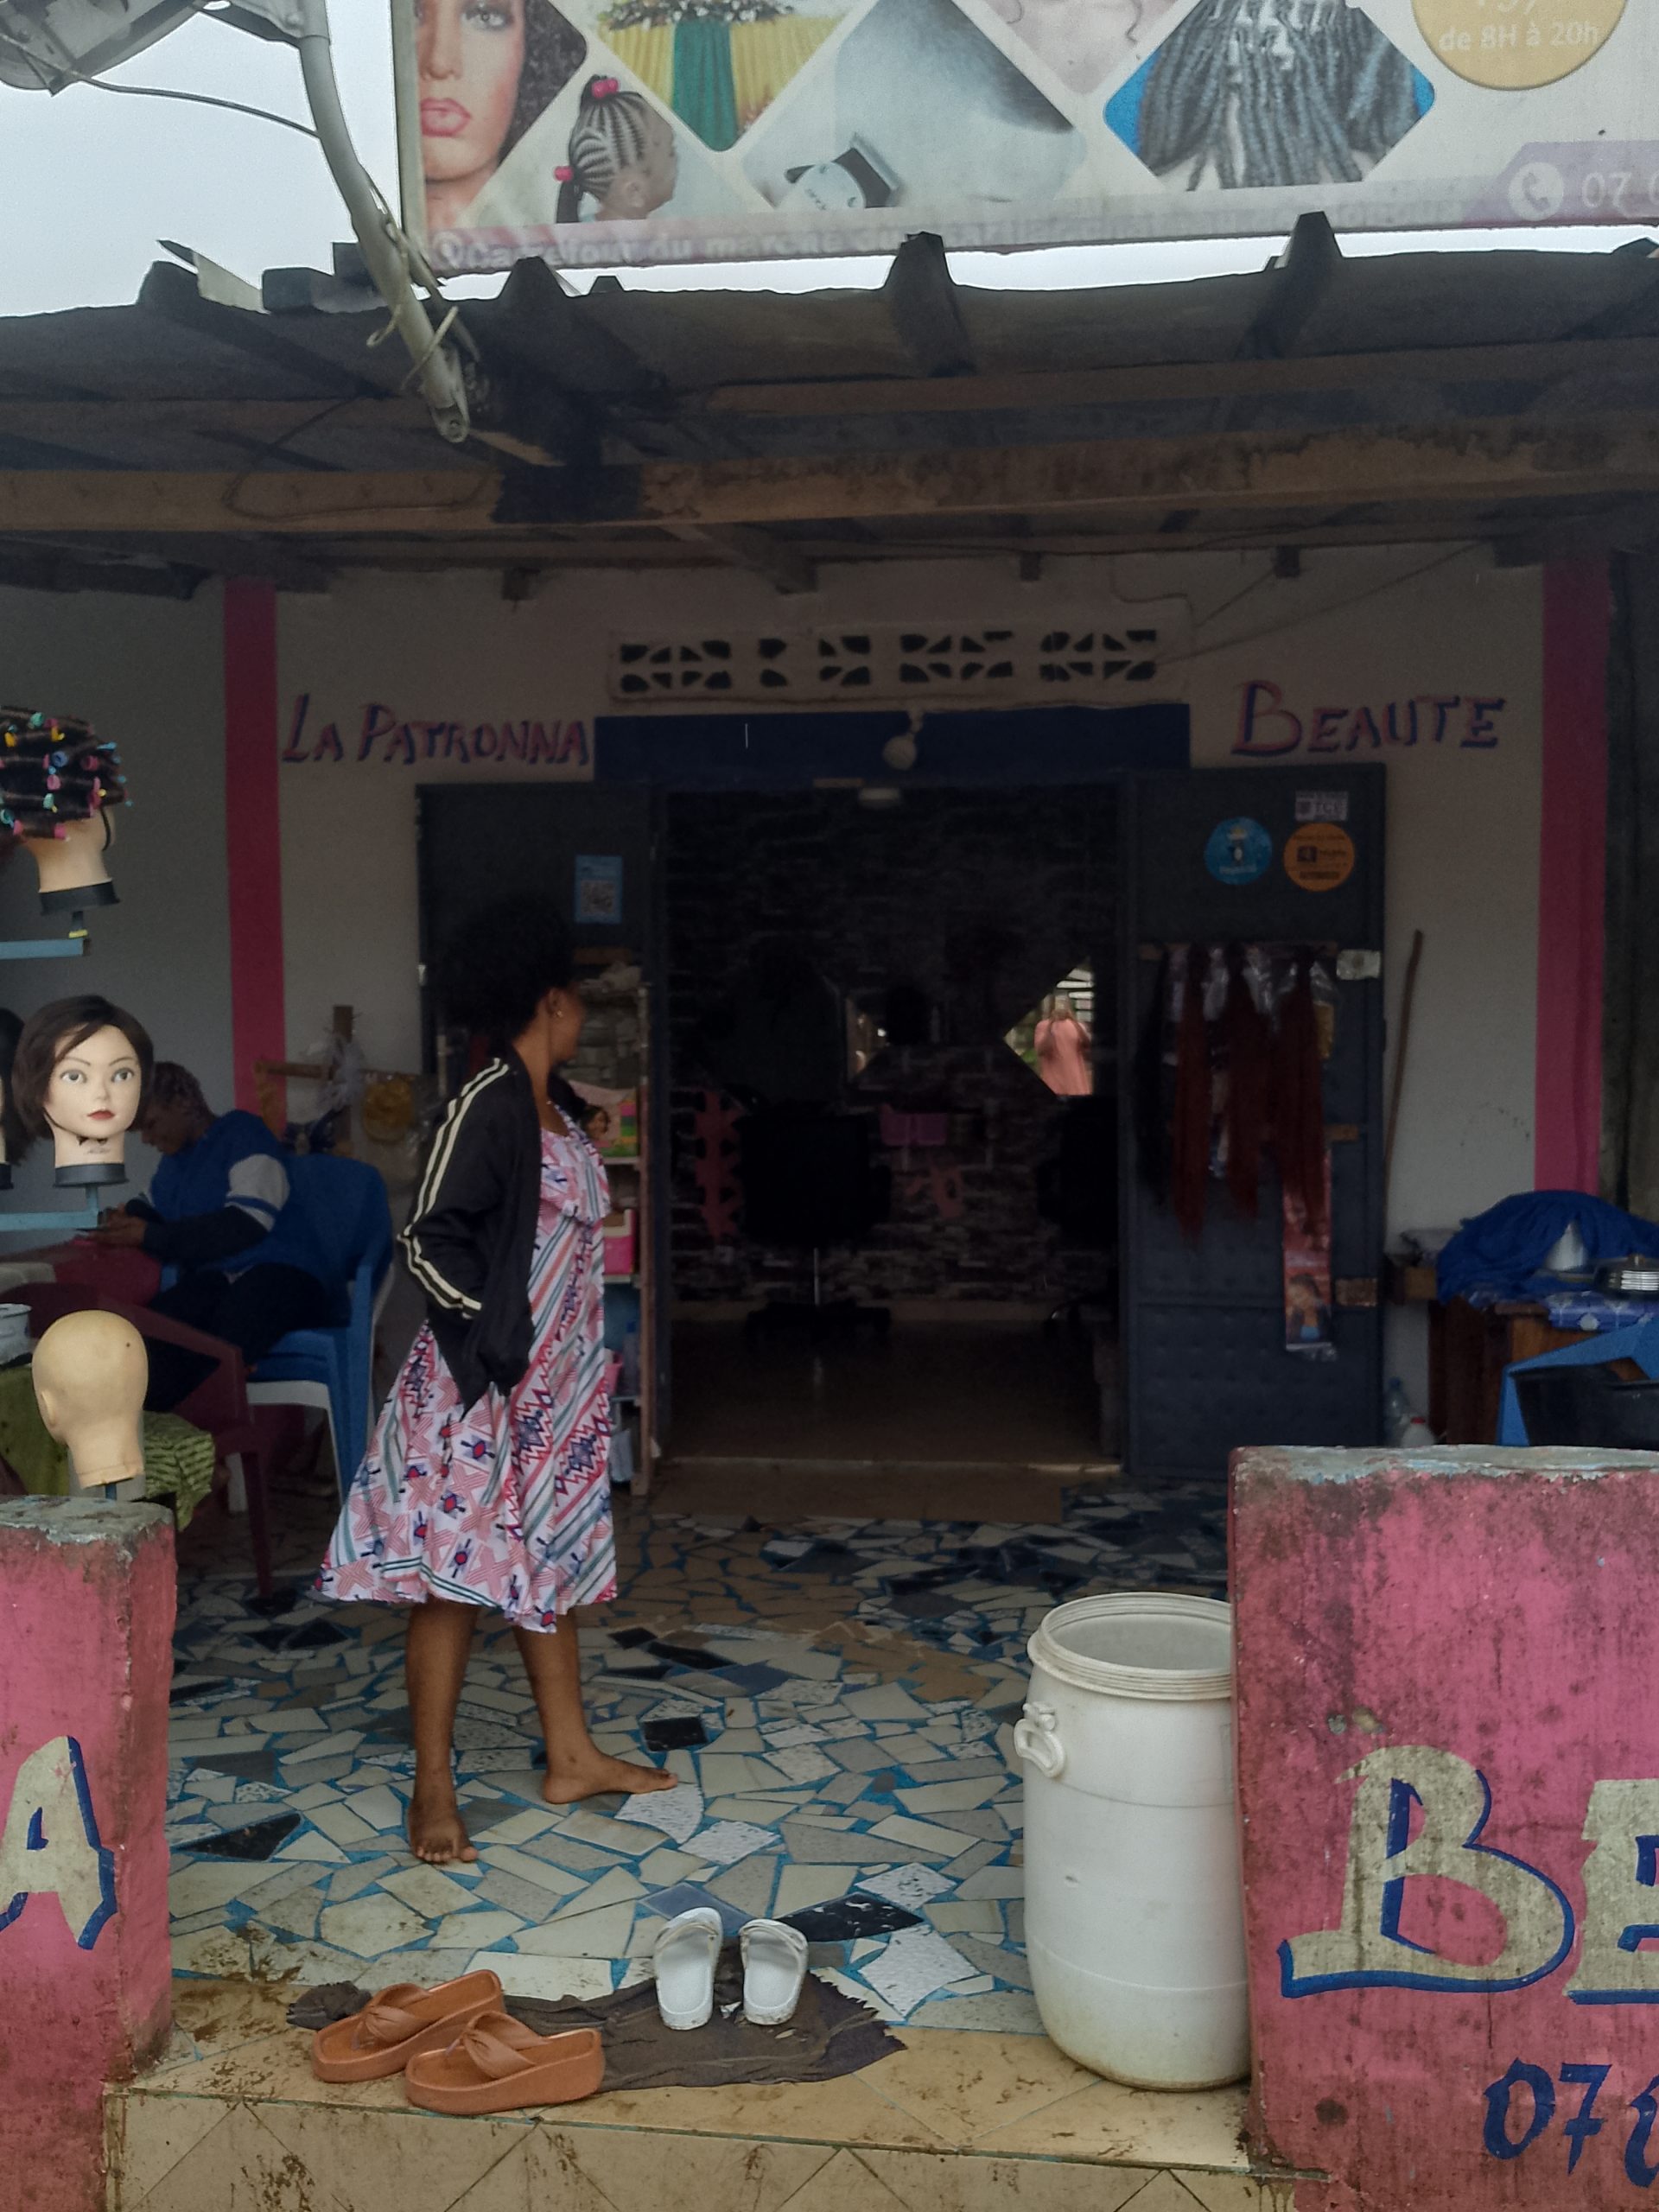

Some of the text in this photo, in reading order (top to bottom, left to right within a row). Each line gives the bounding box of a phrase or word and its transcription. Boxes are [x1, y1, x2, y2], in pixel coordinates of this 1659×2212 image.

[1438, 27, 1471, 51] de
[1550, 20, 1599, 47] 20h
[282, 693, 589, 766] LA PATRONNA
[1230, 679, 1507, 757] BEAUTE
